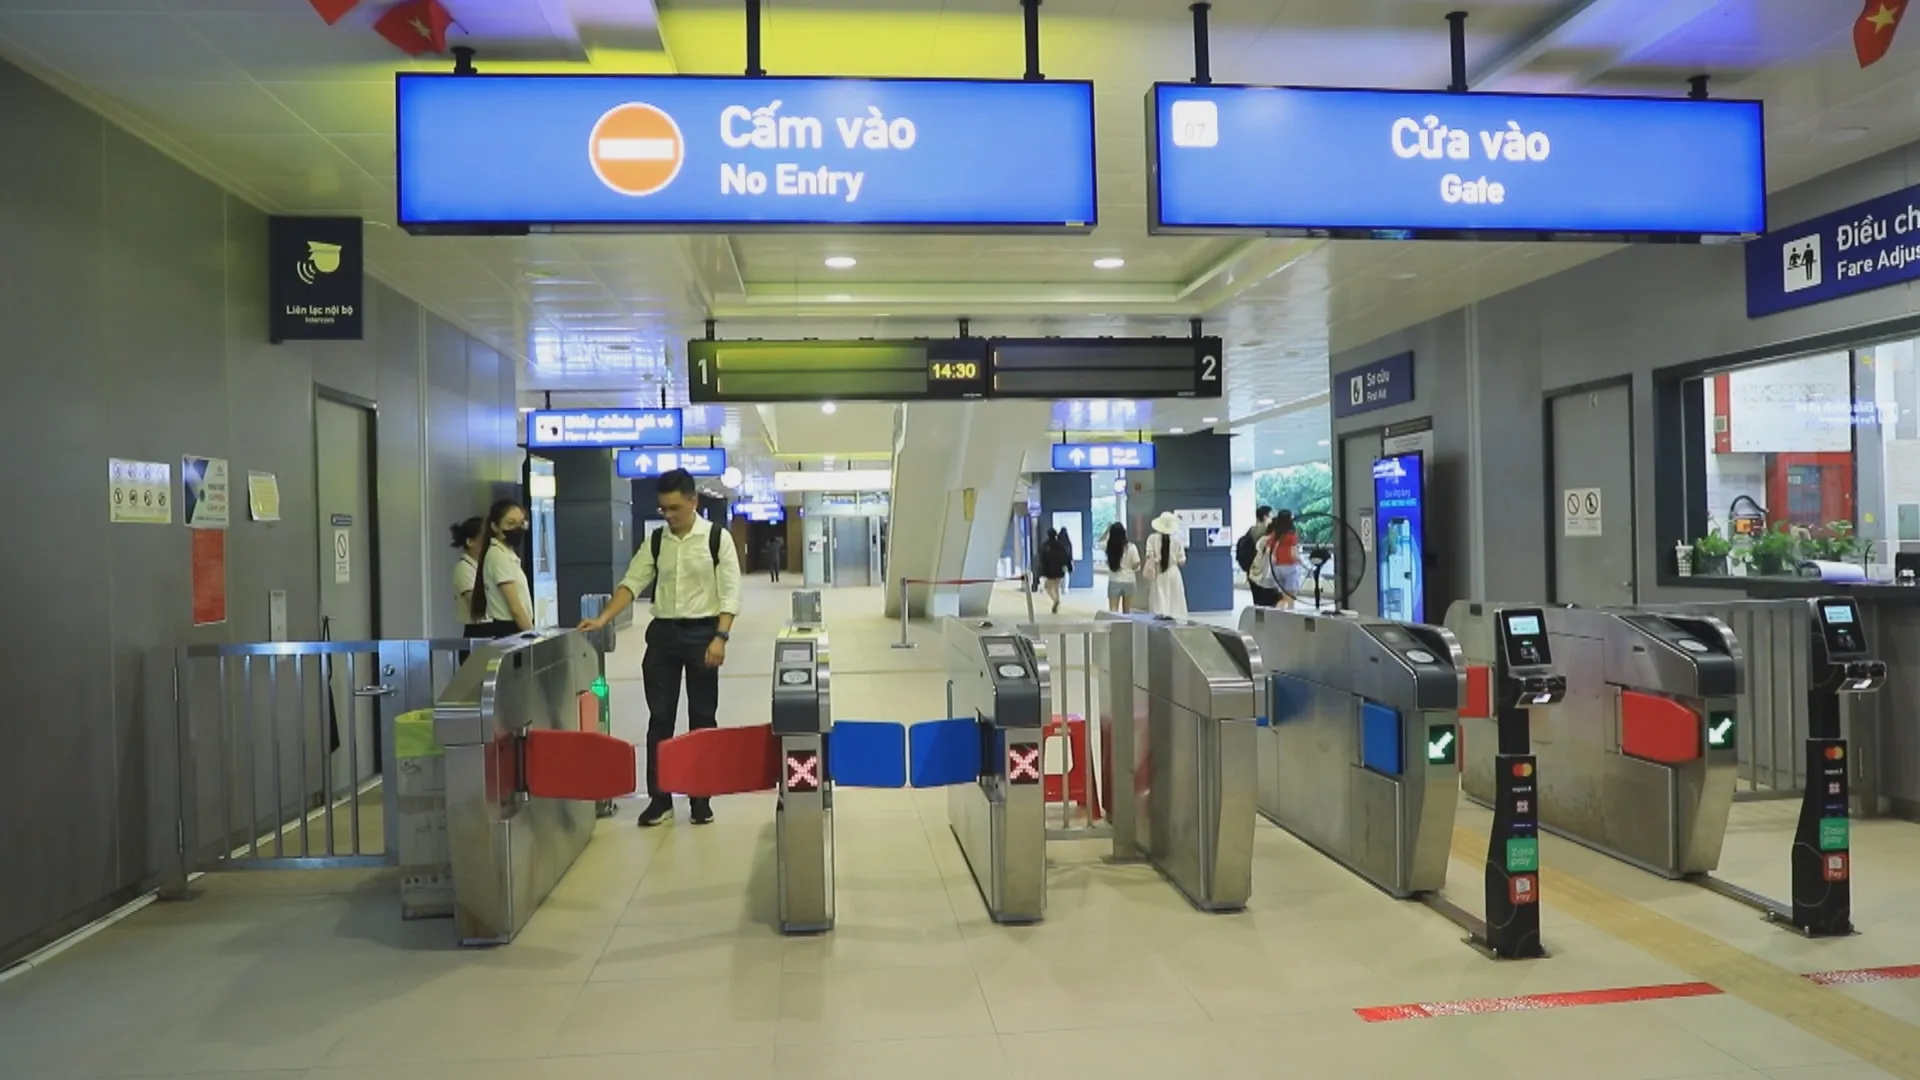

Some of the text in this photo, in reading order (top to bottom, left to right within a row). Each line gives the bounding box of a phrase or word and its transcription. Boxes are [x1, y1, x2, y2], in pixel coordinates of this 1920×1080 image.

[720, 99, 917, 149] Cấm vào
[1184, 122, 1206, 141] 07
[1391, 115, 1551, 161] Cửa vào
[720, 163, 864, 202] No Entry
[1440, 173, 1506, 204] Gate
[1837, 214, 1887, 252] Điều
[1837, 257, 1873, 281] Fare
[286, 305, 307, 315] Liên
[325, 305, 340, 316] nội
[341, 305, 354, 316] bộ
[697, 358, 708, 385] 1
[932, 363, 976, 379] 14:30
[1201, 355, 1217, 381] 2
